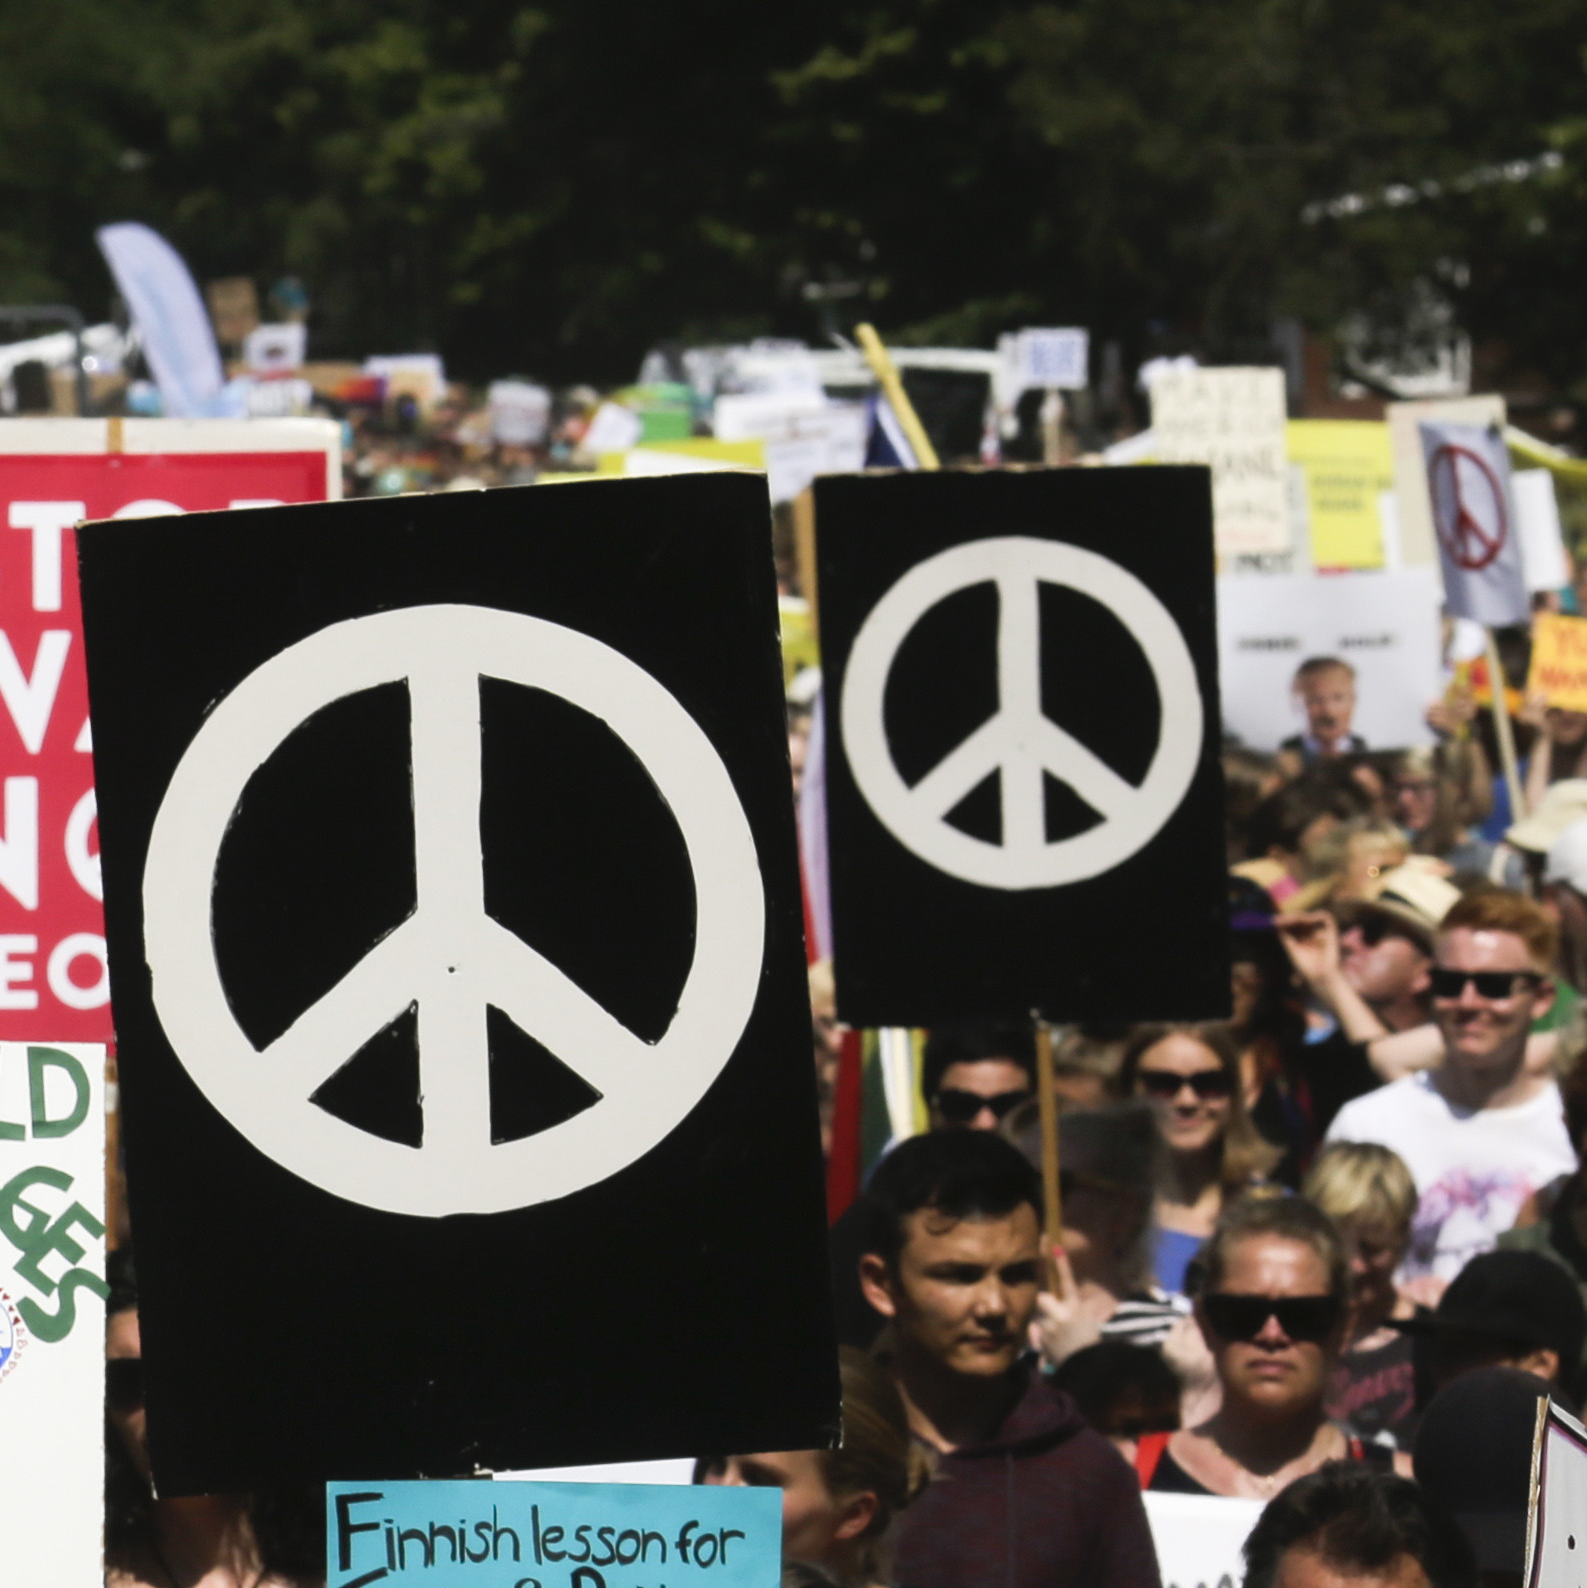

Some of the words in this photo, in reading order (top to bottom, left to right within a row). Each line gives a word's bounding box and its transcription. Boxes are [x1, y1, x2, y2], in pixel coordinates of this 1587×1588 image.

[334, 1492, 520, 1572] Finnish
[531, 1505, 666, 1566] lesson
[674, 1520, 745, 1568] for
